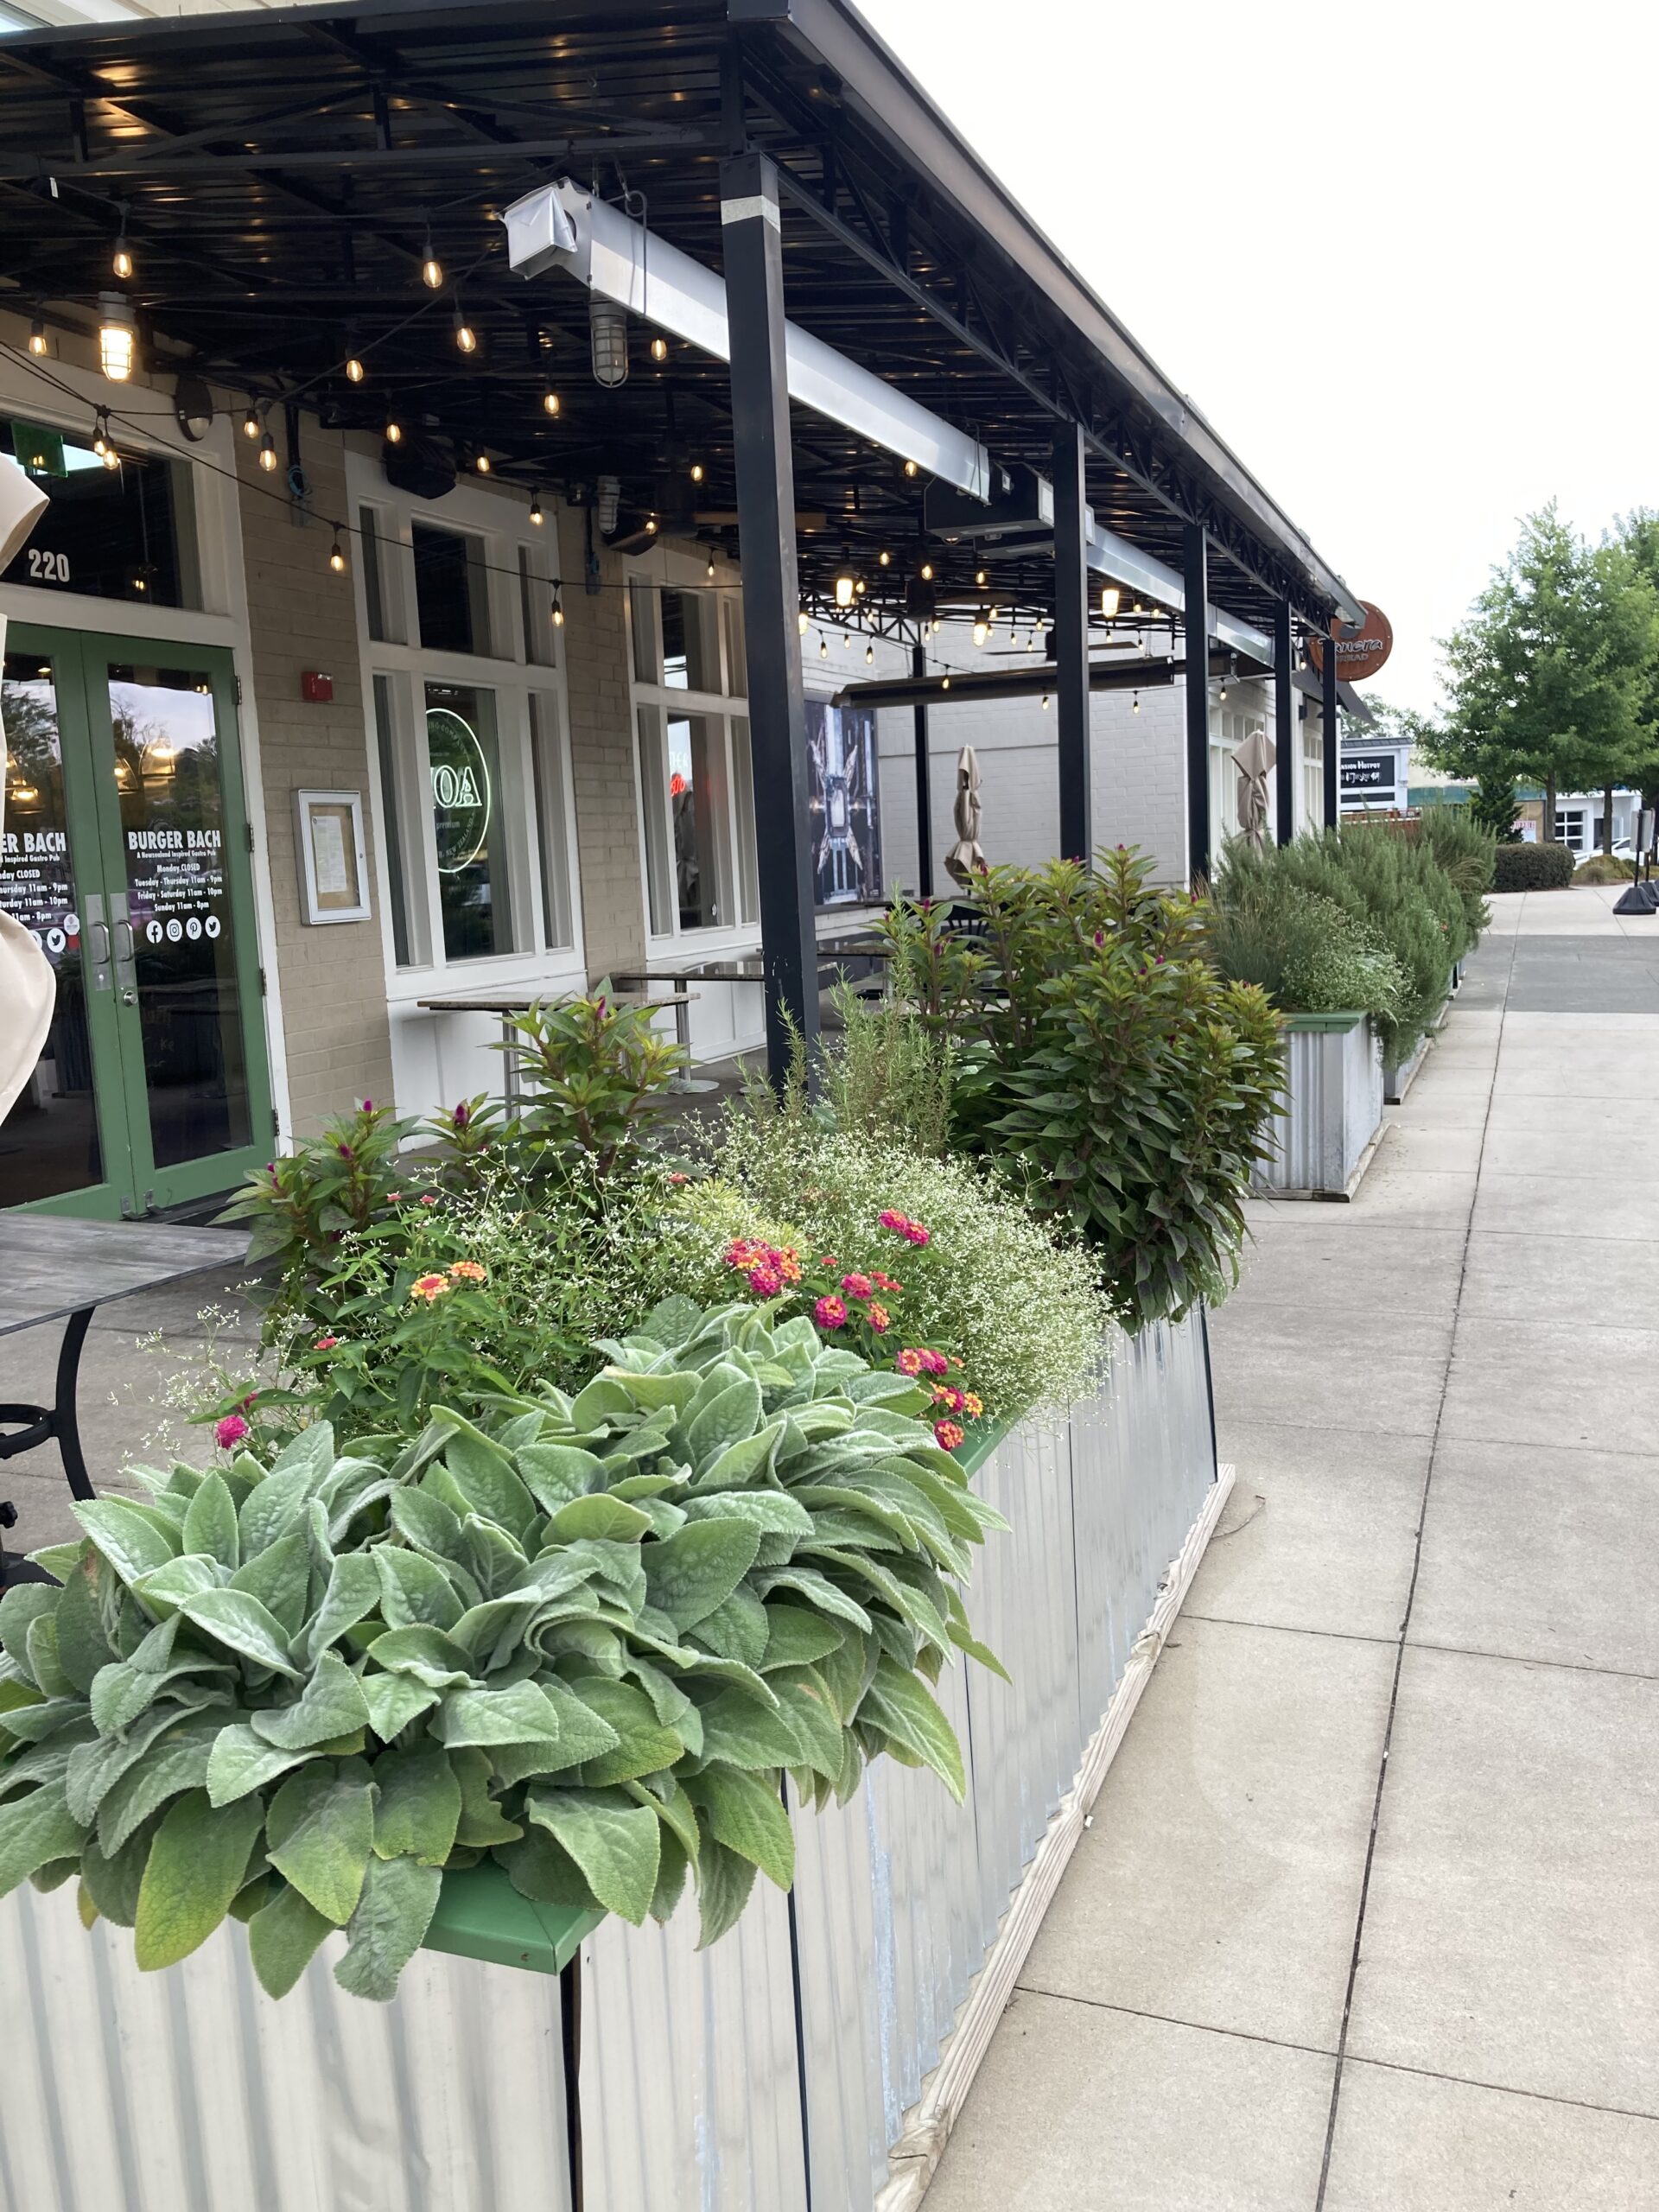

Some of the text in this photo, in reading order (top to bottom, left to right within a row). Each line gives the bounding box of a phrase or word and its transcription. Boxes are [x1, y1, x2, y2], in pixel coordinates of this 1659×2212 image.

[29, 549, 70, 582] 220
[430, 765, 483, 809] OA
[23, 832, 67, 853] BACH
[128, 830, 221, 850] BURGER BACH
[4, 854, 29, 864] Inspired
[29, 853, 48, 862] Gastro
[48, 853, 60, 861] Pub
[172, 849, 190, 858] Inspired
[16, 868, 41, 879] CLOSED
[156, 863, 200, 874] Monday CLOSED
[135, 878, 159, 887] Tuesday
[163, 875, 189, 886] Thursday
[190, 875, 207, 884] 11am
[210, 874, 223, 885] 9pm
[29, 883, 48, 893] 11am
[53, 882, 68, 893] 9pm
[137, 891, 156, 900] Friday
[161, 889, 186, 899] Saturday
[207, 887, 223, 897] 10pm
[24, 897, 44, 906] 11am
[49, 896, 68, 907] 10pm
[155, 902, 175, 912] Sunday
[176, 901, 193, 910] 11am
[196, 899, 209, 910] 8pm
[35, 911, 53, 922] 8pm
